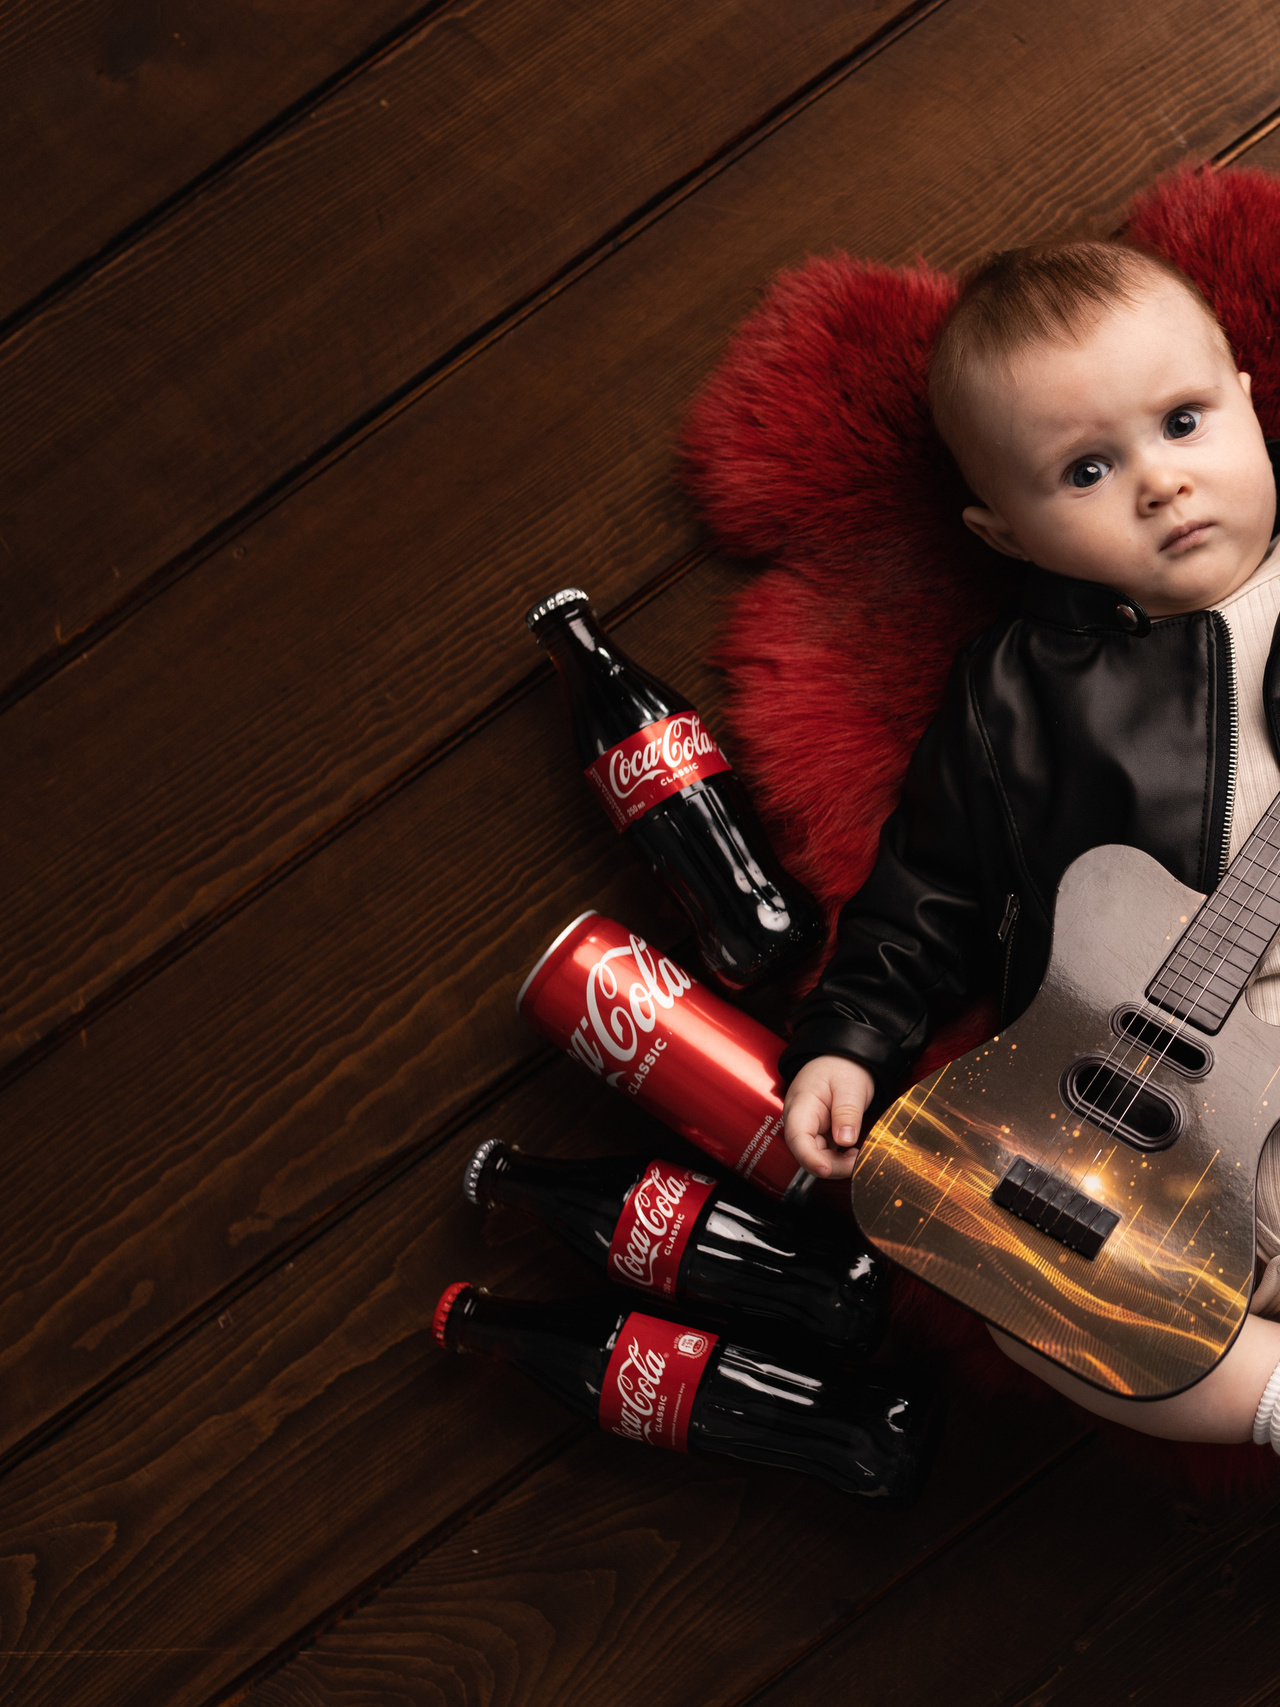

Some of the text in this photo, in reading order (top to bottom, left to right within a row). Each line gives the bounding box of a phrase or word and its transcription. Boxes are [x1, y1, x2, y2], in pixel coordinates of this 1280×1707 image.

[609, 715, 713, 799] Coca-Cola
[660, 762, 699, 787] CLASSIC
[627, 1037, 667, 1095] CLASSIC
[613, 1166, 687, 1286] Coca-Cola
[664, 1213, 685, 1256] CLASSIC
[655, 1394, 668, 1433] CLASSIC
